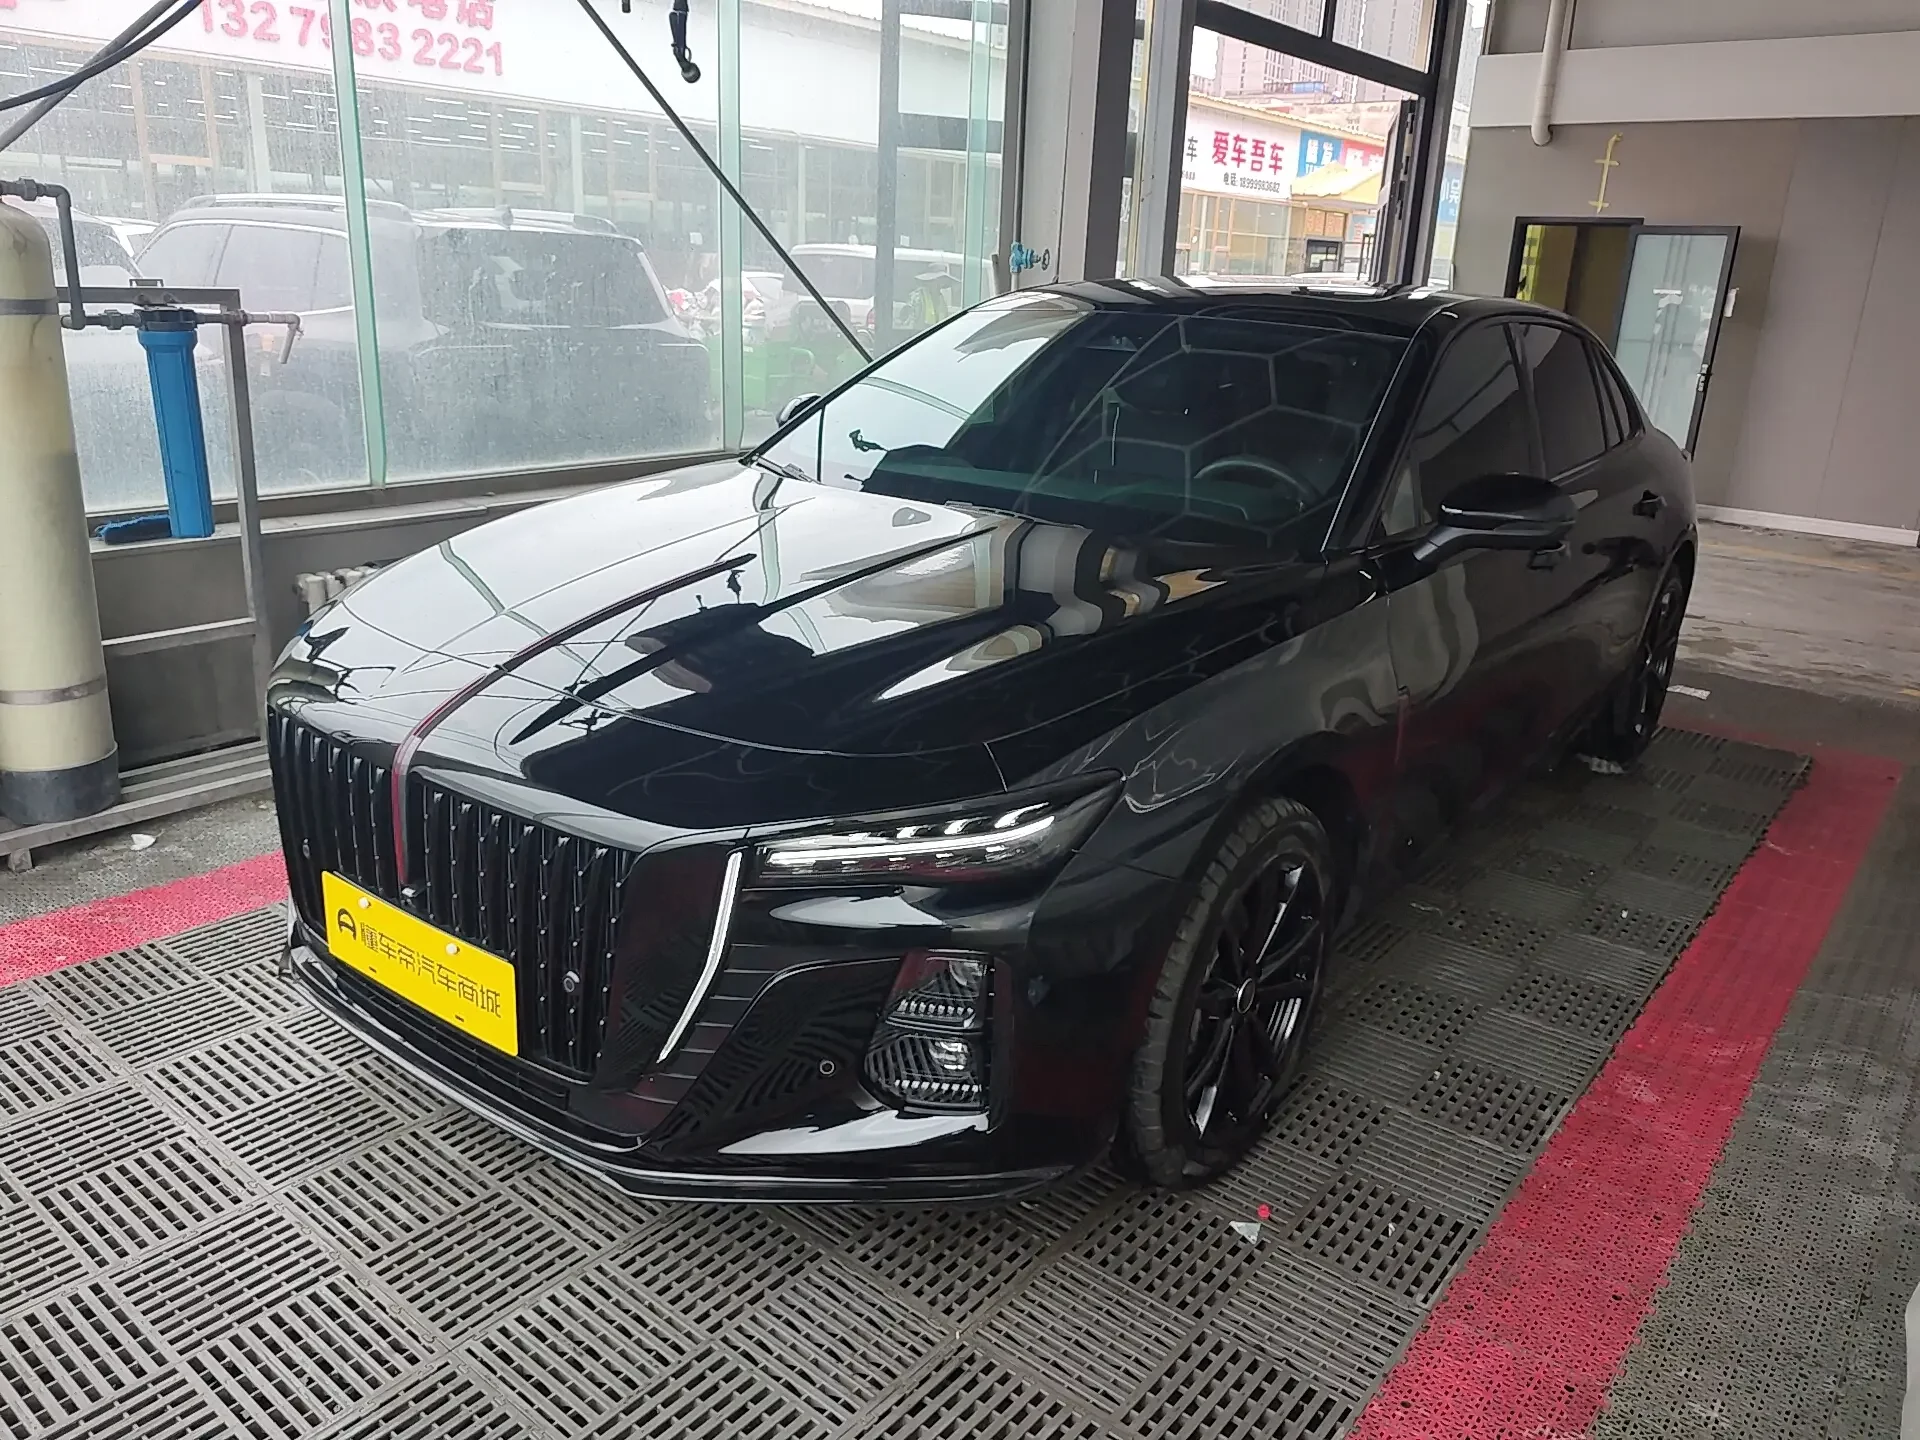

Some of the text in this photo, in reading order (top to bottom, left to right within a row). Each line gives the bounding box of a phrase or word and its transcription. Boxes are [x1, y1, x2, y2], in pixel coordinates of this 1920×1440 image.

[201, 0, 281, 41] 132
[411, 28, 504, 76] 2221
[1186, 136, 1198, 162] 车
[1212, 131, 1285, 175] 爱车吾车
[360, 922, 502, 1018] 懂车帝汽车商城
